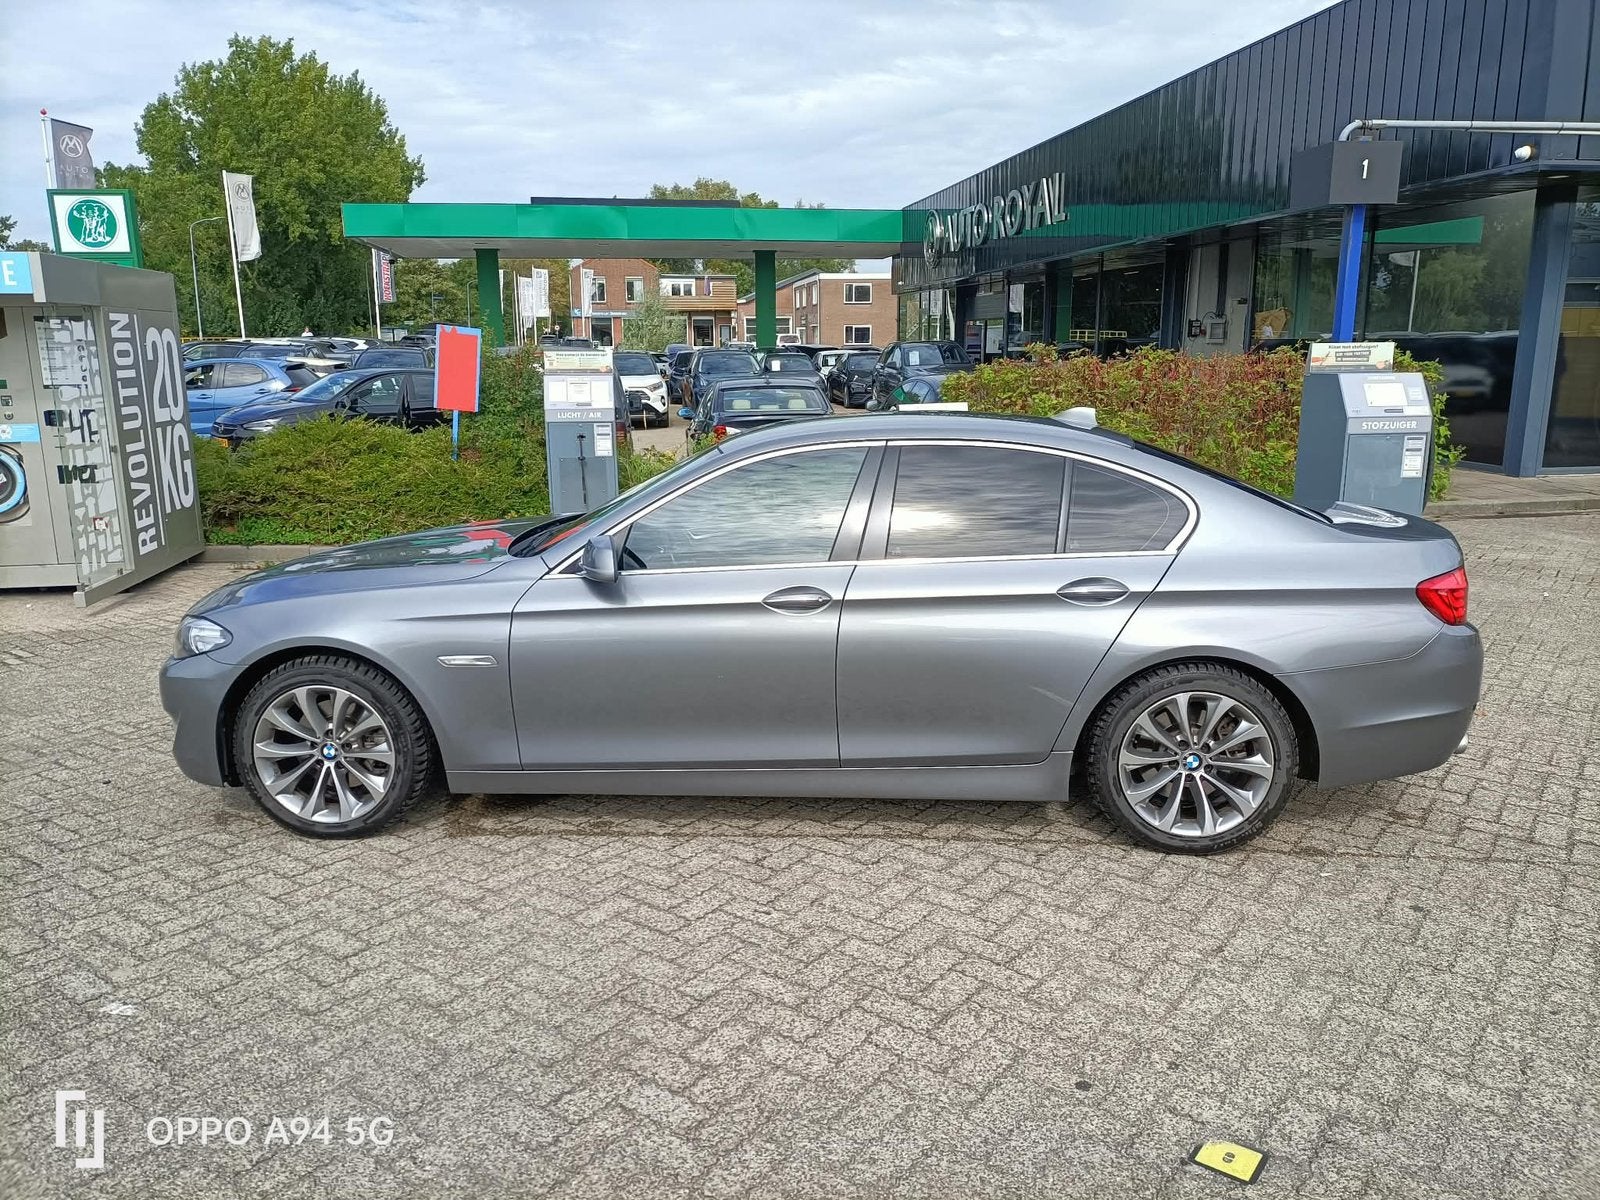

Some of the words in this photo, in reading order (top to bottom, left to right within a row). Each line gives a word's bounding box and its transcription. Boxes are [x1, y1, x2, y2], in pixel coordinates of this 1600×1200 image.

[1362, 158, 1369, 179] 1
[2, 259, 18, 286] E
[144, 326, 184, 423] 20
[557, 411, 581, 419] LUCHT
[588, 411, 602, 419] AIR
[1362, 420, 1417, 430] STOFZUIGER
[108, 312, 158, 556] REVOLUTION
[155, 422, 194, 514] KG
